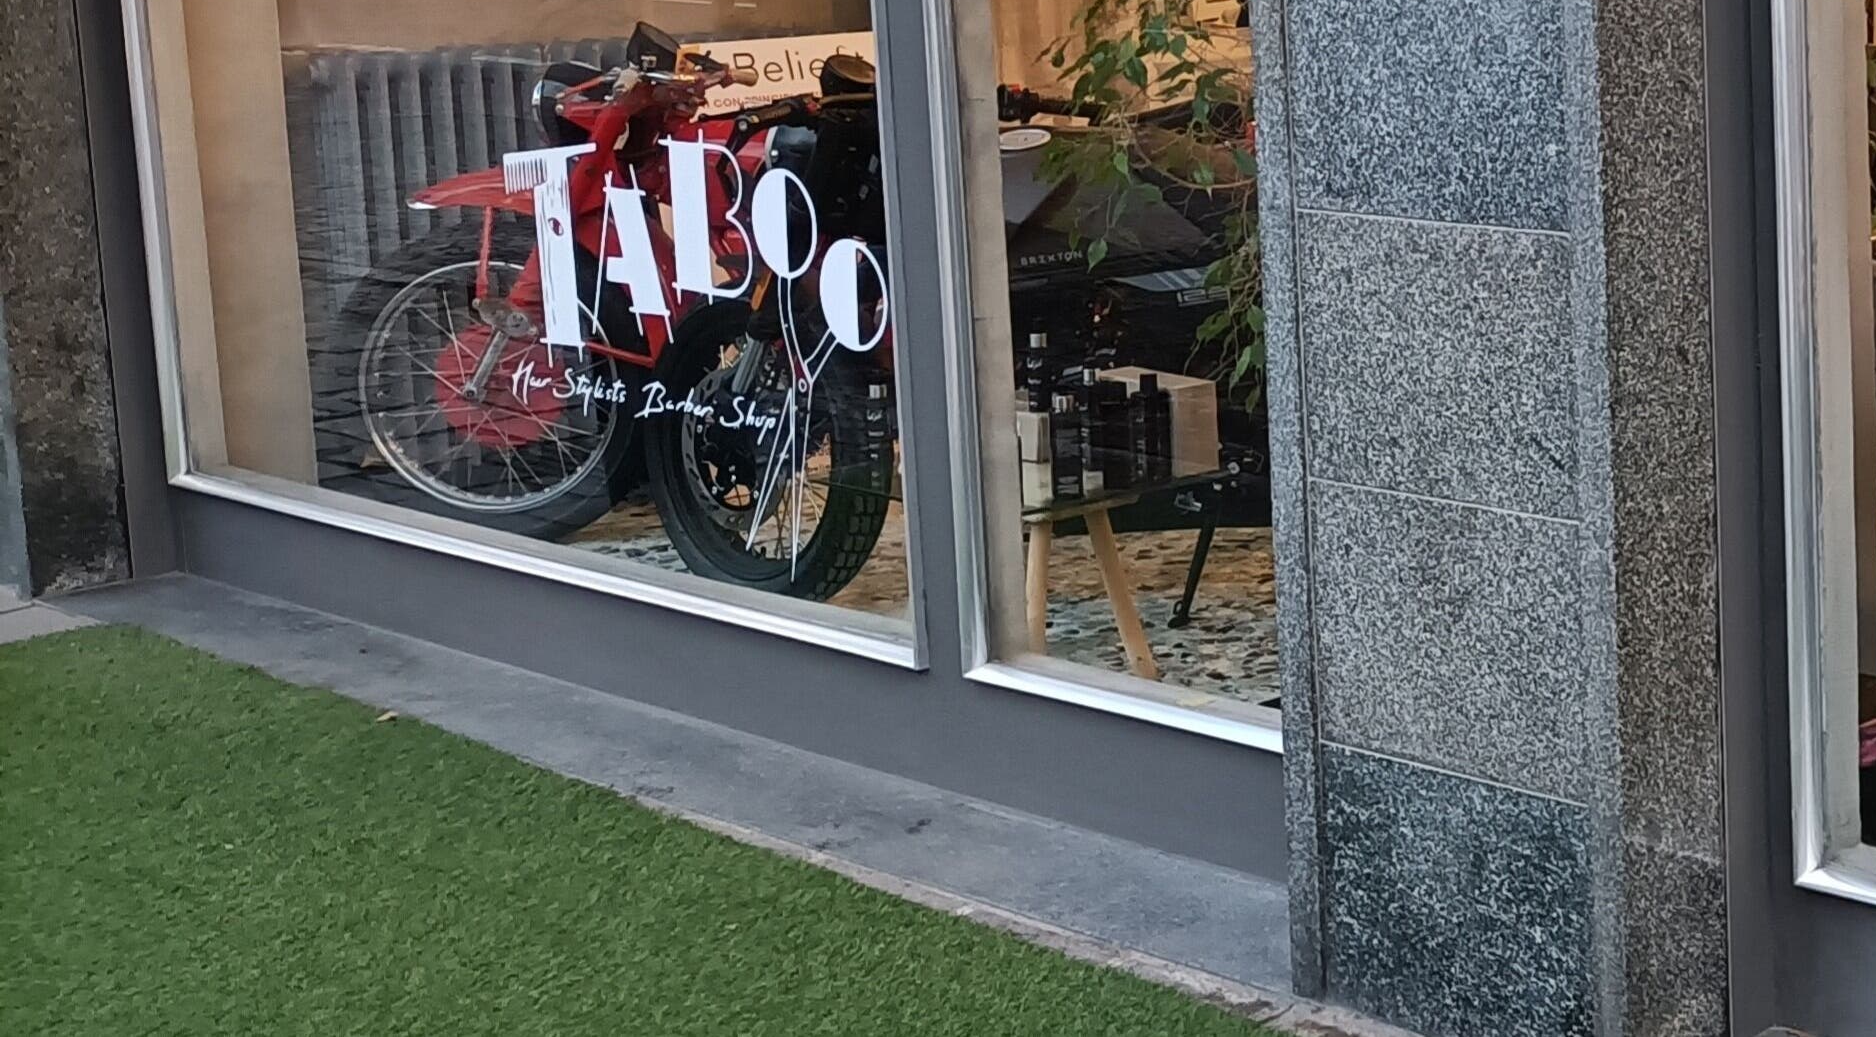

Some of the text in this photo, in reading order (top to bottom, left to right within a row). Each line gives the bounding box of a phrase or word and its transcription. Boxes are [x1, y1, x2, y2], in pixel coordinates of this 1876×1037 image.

[503, 129, 889, 368] TABOO
[1019, 250, 1084, 267] BRIXTON
[552, 368, 627, 417] Stylists
[634, 381, 714, 419] Barber
[719, 396, 777, 446] Shop
